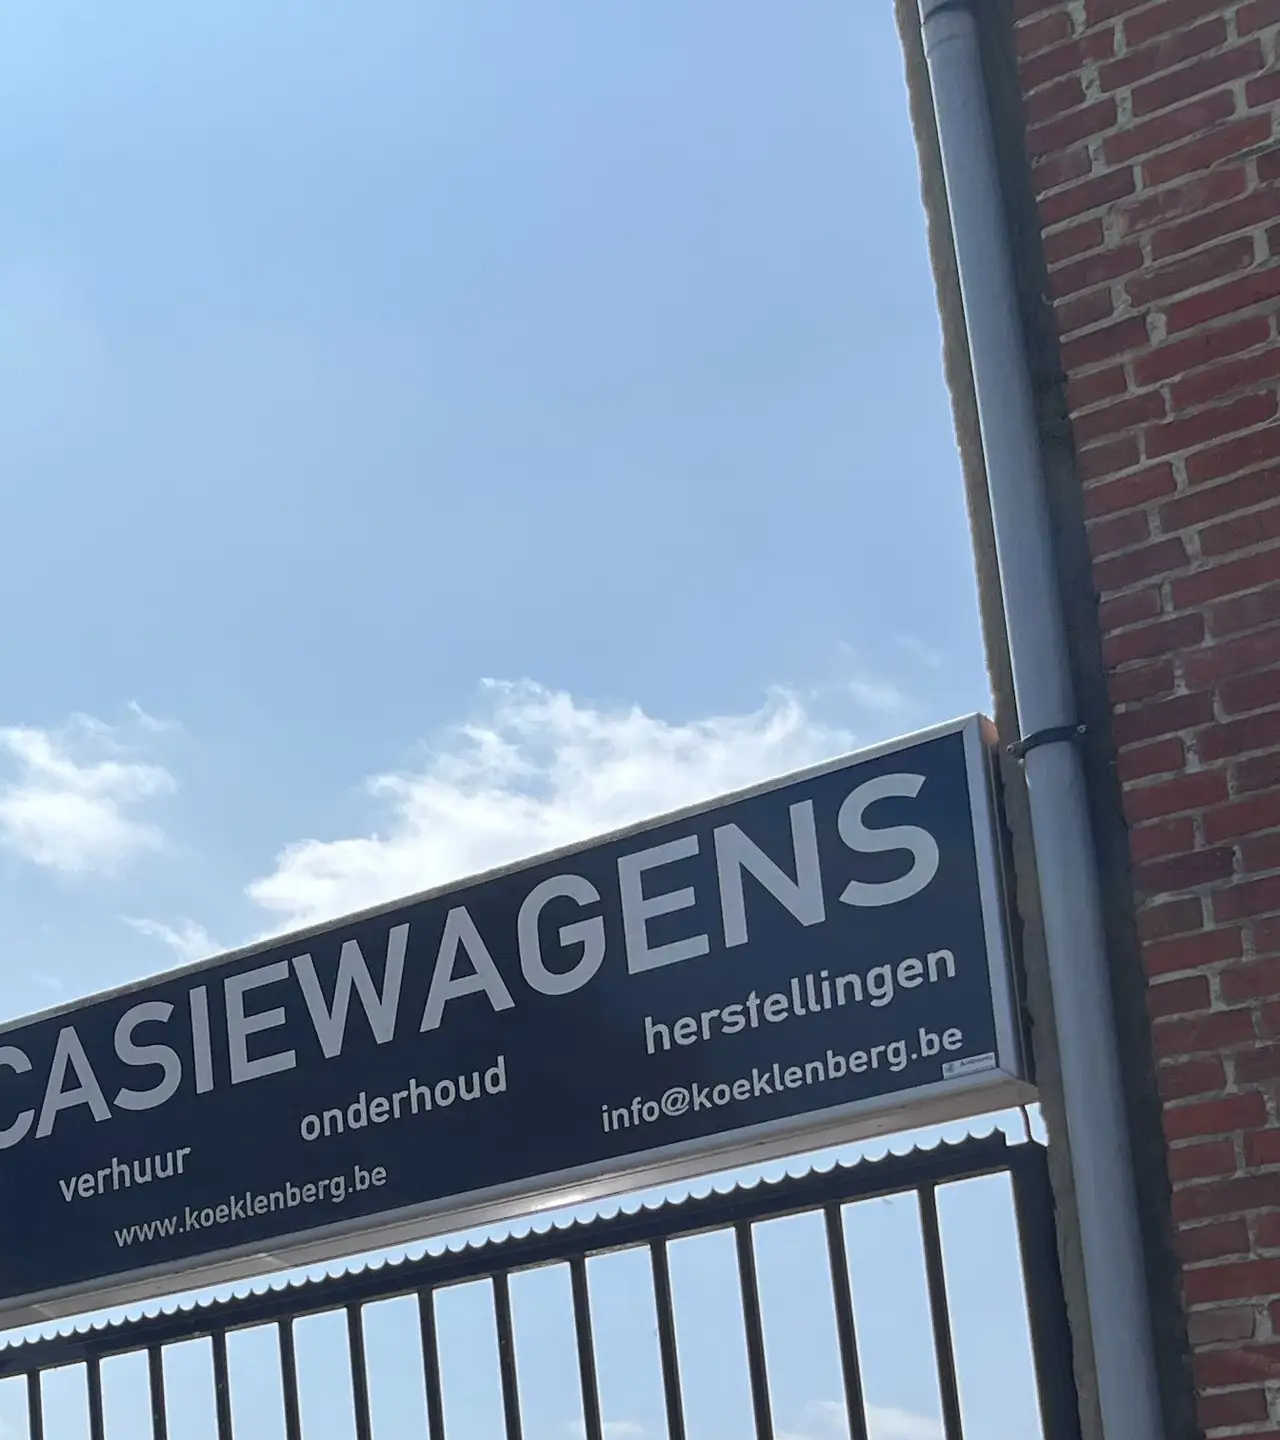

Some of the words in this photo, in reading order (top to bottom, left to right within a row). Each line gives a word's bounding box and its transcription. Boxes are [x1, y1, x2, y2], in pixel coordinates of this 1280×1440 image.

[58, 1146, 192, 1202] verhuur
[300, 1054, 508, 1142] onderhoud
[643, 948, 956, 1055] herstellingen
[113, 1164, 388, 1248] www.koeklenberg.be
[600, 1026, 964, 1133] info@koeklenberg.be
